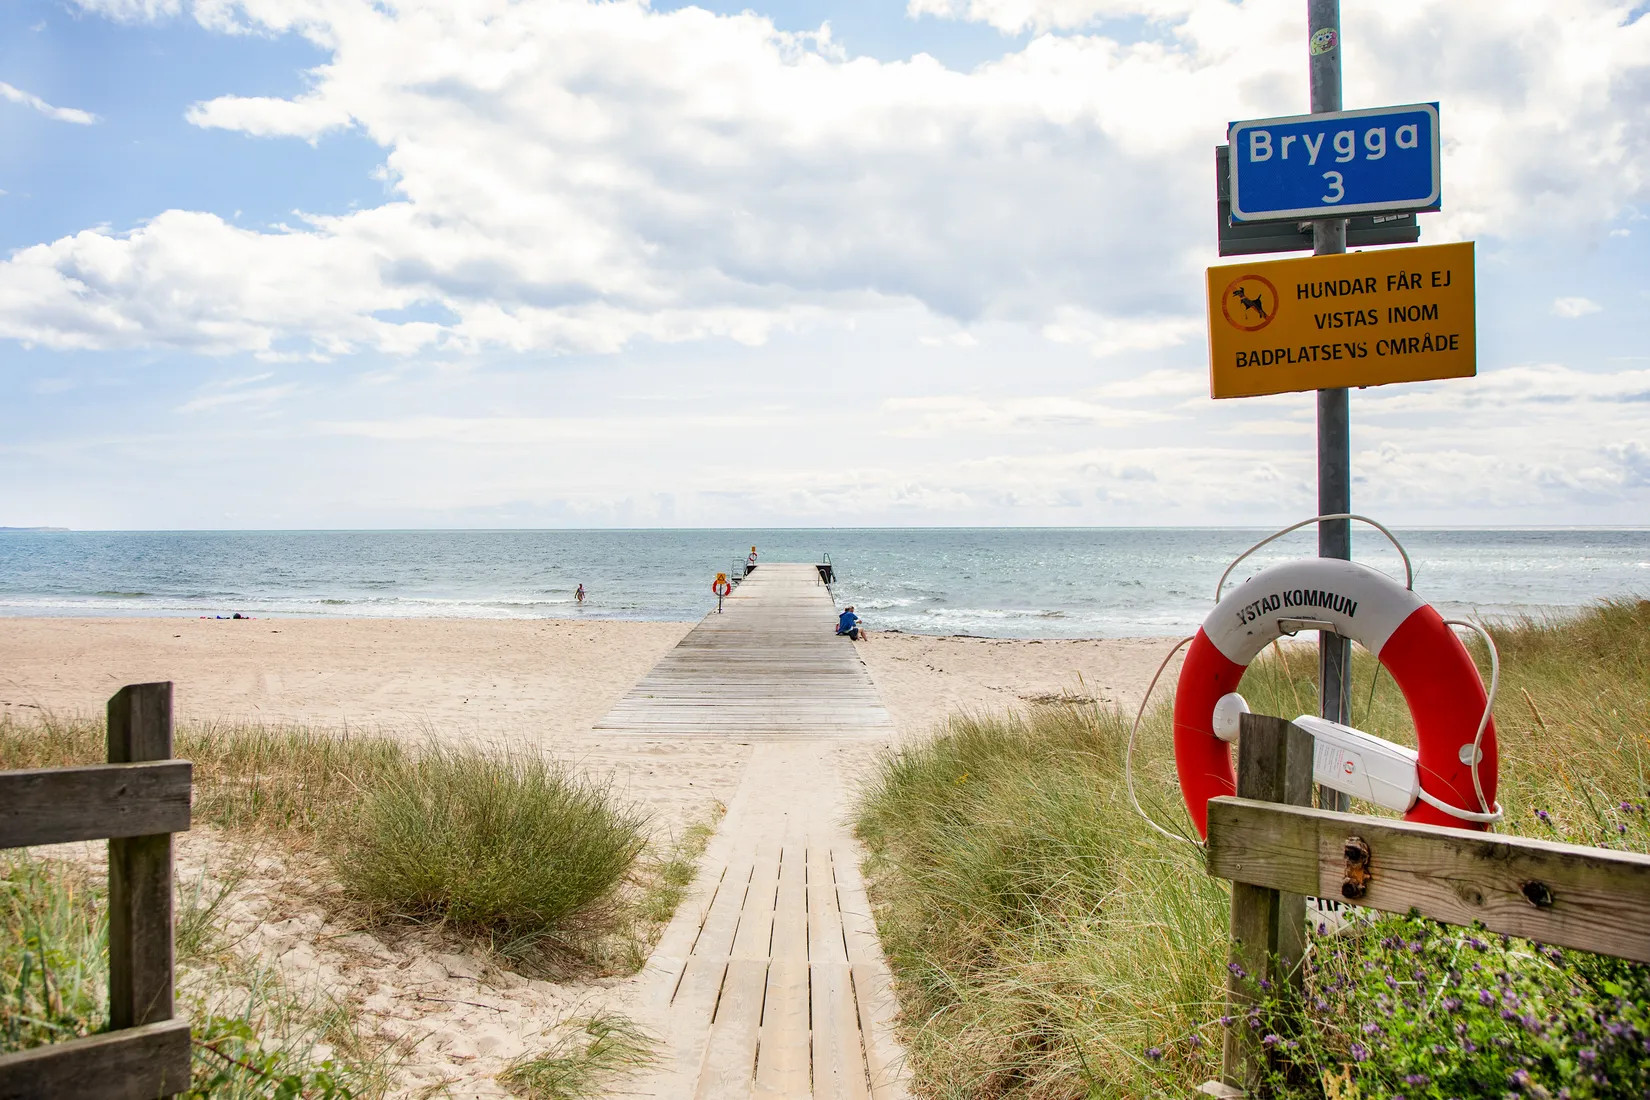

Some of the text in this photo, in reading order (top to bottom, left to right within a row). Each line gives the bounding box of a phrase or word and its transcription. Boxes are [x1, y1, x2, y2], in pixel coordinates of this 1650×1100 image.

[1250, 123, 1418, 165] Brygga
[1321, 171, 1345, 203] 3
[1297, 270, 1451, 300] HUNDAR FÅR EJ
[1314, 304, 1439, 330] VISTAS INOM
[1236, 332, 1459, 368] BADPLATSENS OMRÅDE
[1236, 589, 1358, 625] YSTAD KOMMUN
